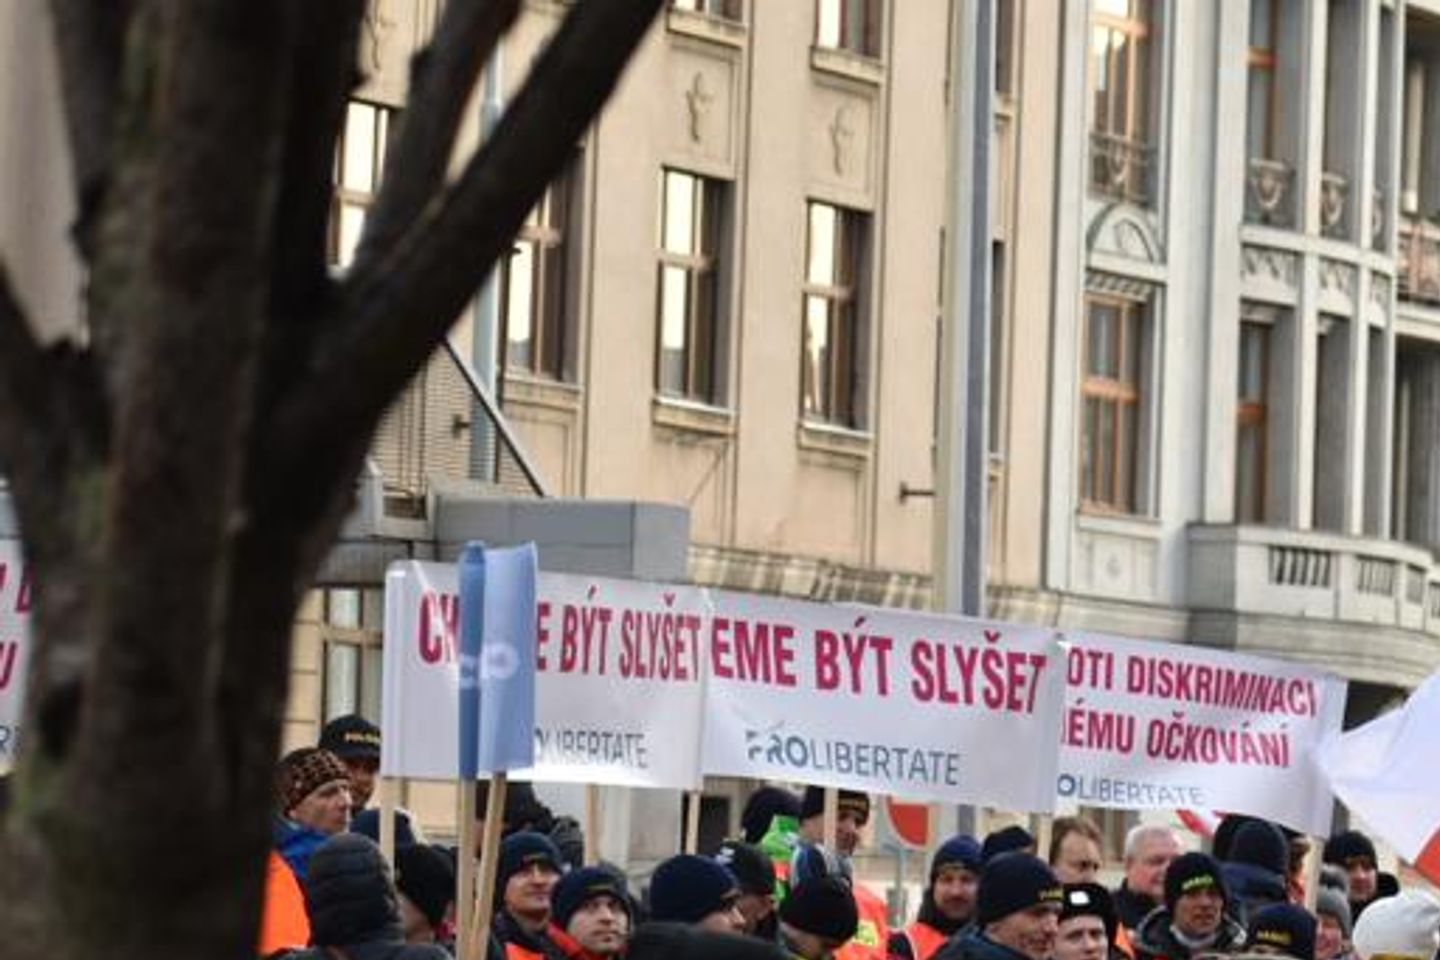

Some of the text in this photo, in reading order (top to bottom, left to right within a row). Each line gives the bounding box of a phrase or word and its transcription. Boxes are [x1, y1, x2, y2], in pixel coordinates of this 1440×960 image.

[559, 585, 612, 676] BÝT
[619, 592, 701, 681] SLYŠET
[711, 615, 1048, 714] EME BÝT SLYŠET
[1067, 646, 1318, 718] OTI DISKRIMINACI
[1062, 697, 1290, 769] ÉMU OČKOVÁNÍ
[1056, 773, 1206, 805] OLIBERTATE
